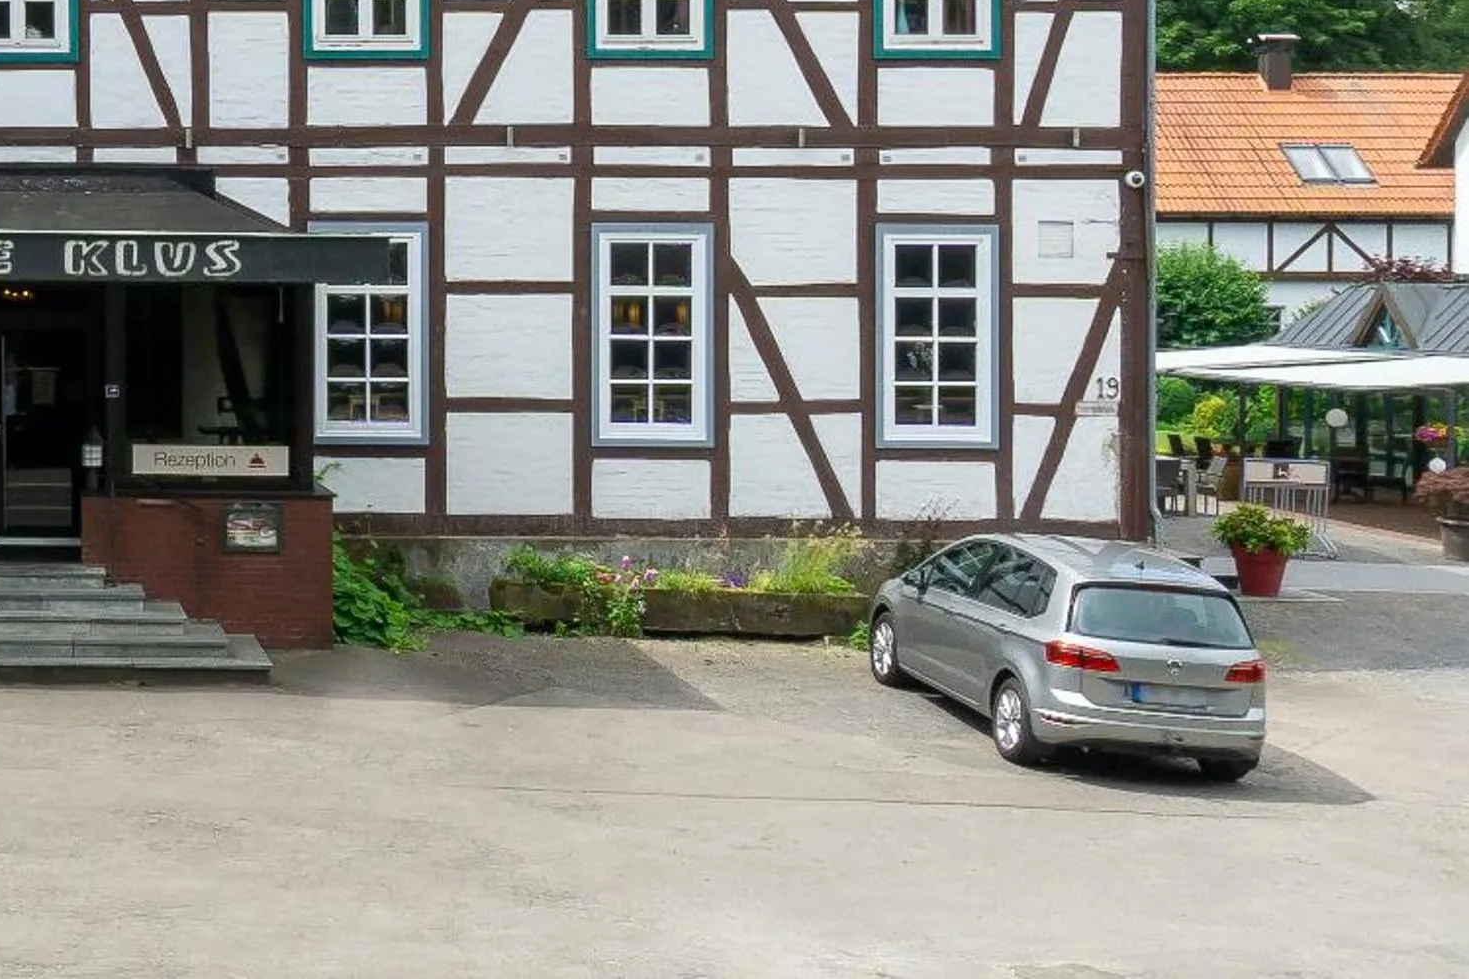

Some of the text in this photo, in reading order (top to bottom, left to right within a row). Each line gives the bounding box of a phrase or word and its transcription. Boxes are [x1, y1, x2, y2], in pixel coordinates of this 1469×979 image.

[63, 239, 242, 277] KLUS
[1096, 376, 1120, 400] 19
[153, 451, 237, 470] Rezeption
